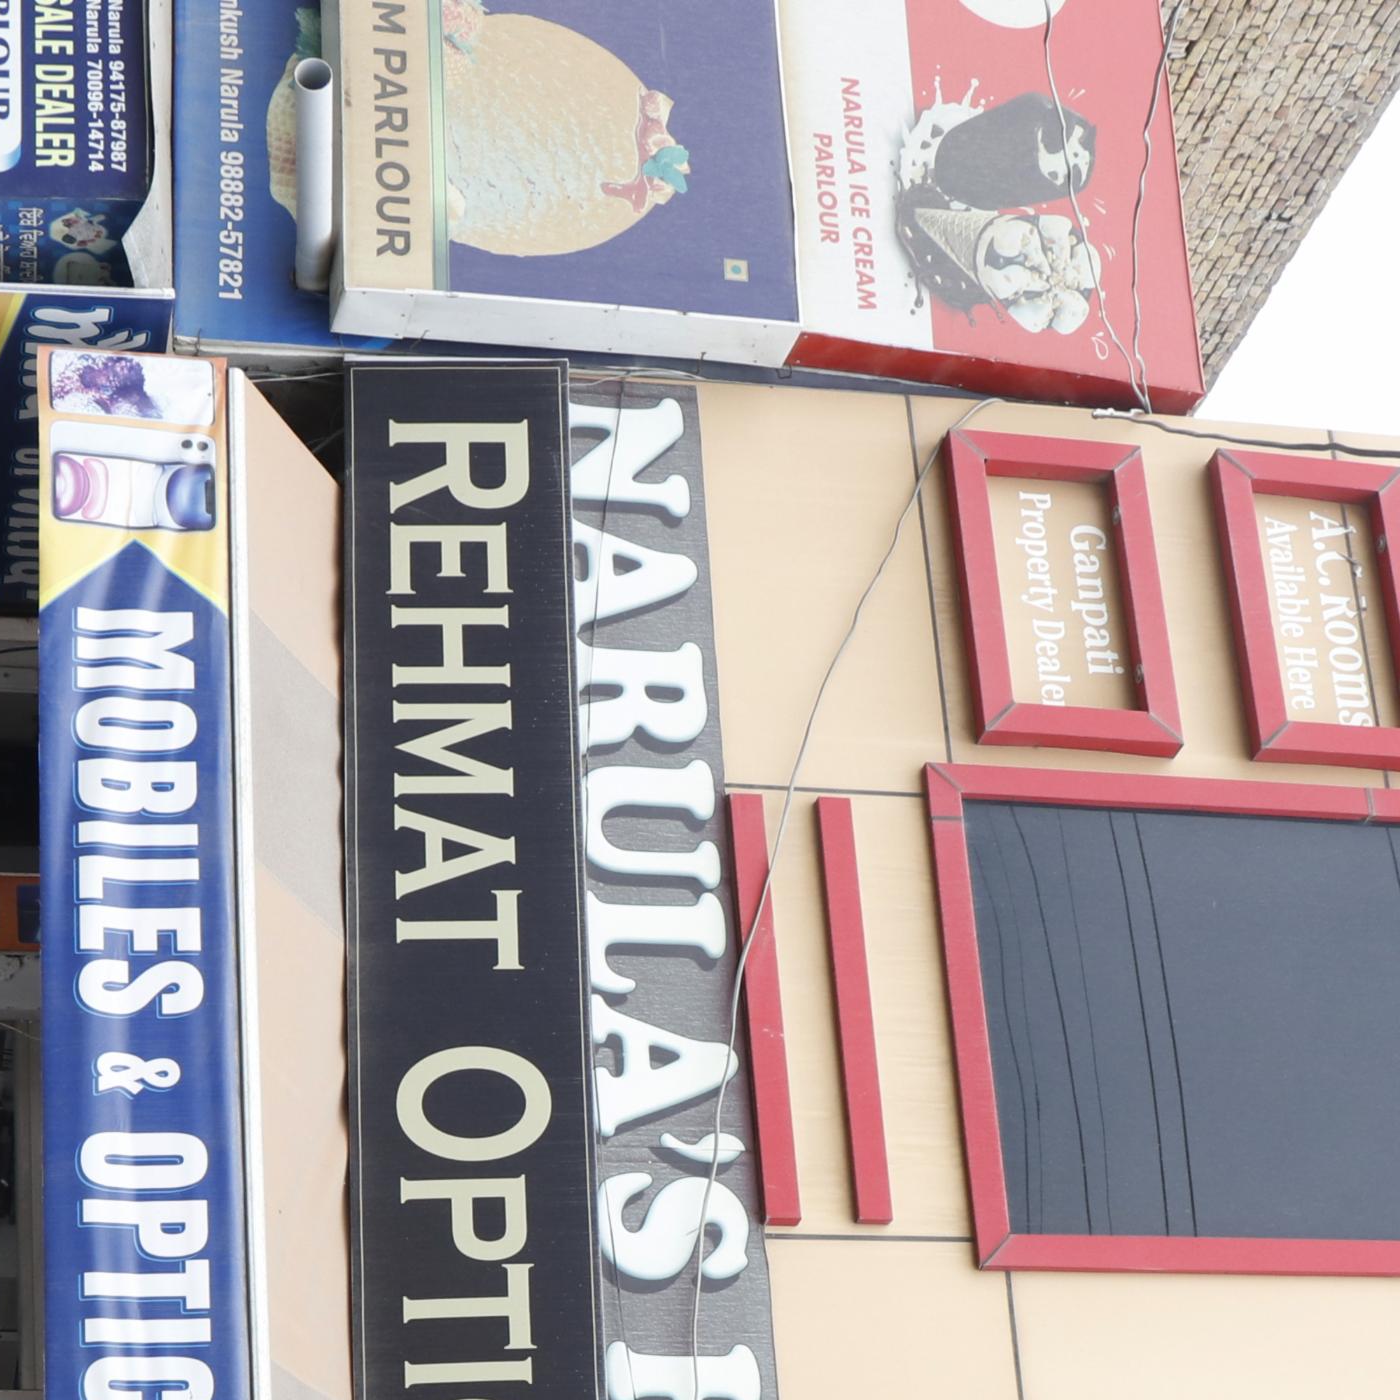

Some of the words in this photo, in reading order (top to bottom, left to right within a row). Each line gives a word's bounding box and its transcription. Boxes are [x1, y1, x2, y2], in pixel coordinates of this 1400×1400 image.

[85, 0, 103, 54] Narula
[107, 0, 125, 54] Narula
[33, 64, 75, 168] DEALER
[86, 59, 104, 173] 70096-14714
[108, 60, 127, 173] 94175-87987
[219, 68, 244, 142] Narula
[372, 47, 412, 257] PARLOUR
[840, 76, 869, 175] NARULA
[217, 150, 244, 301] 98882-57821
[812, 132, 840, 244] PARLOUR
[847, 183, 872, 218] ICE
[851, 226, 878, 311] CREAM
[1015, 490, 1059, 613] Property
[1068, 524, 1124, 676] Ganpati
[1263, 515, 1312, 638] Available
[387, 419, 530, 970] REHMAT
[1283, 645, 1320, 710] Here
[1318, 593, 1374, 727] Rooms
[73, 607, 208, 1012] MOBILES
[572, 395, 752, 1281] NARULA'S
[96, 1050, 183, 1097] &
